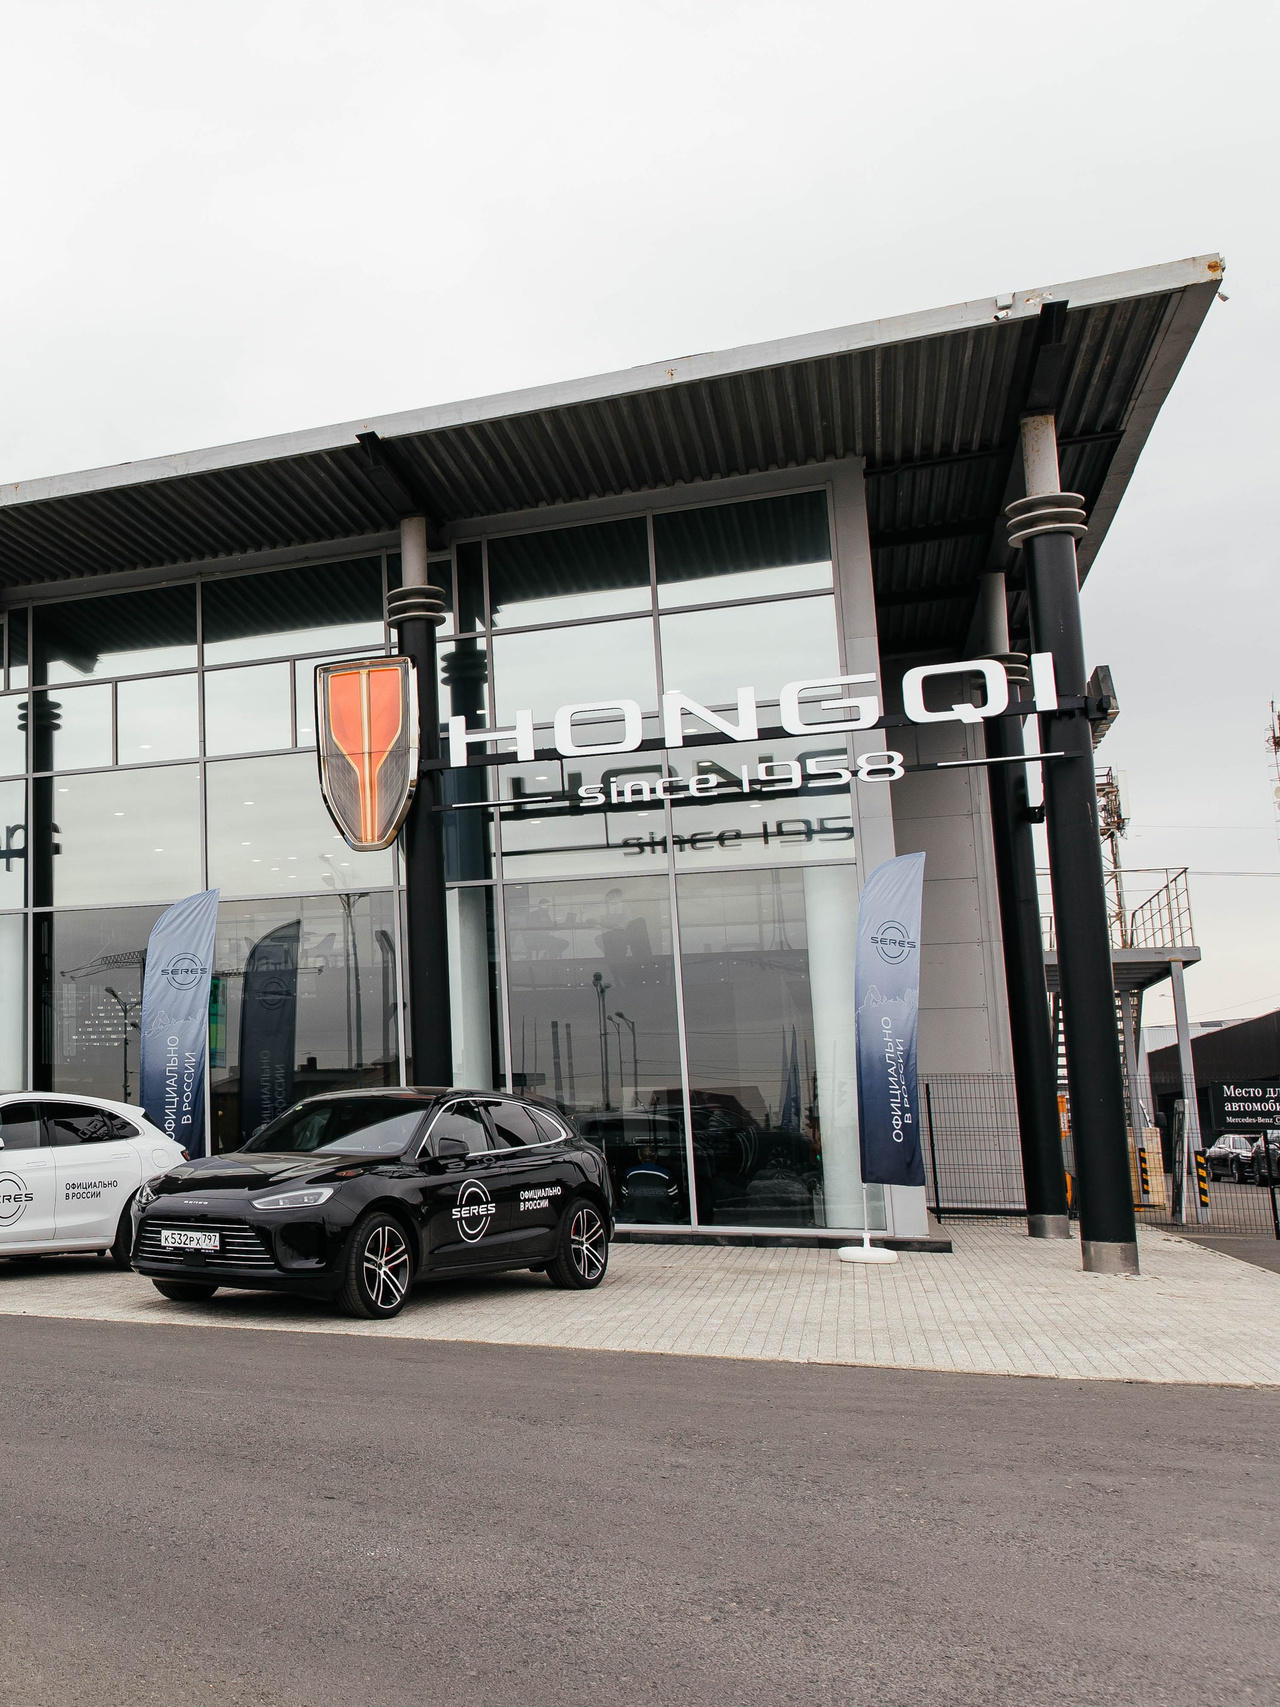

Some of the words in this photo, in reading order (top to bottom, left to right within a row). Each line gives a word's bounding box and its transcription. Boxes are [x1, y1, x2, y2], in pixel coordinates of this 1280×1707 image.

[448, 652, 1058, 767] HONGQI
[577, 774, 719, 807] since
[740, 750, 905, 793] 1958
[870, 936, 917, 949] SERES
[160, 967, 208, 976] SERES
[895, 1037, 911, 1109] РОССИИ
[182, 1051, 196, 1111] РОССИИ
[881, 1016, 904, 1144] ОФИЦИАЛЬНО
[1222, 1084, 1263, 1097] Место
[181, 1114, 192, 1125] В
[903, 1111, 913, 1124] В
[1226, 1116, 1274, 1124] Mercedes-Benz
[65, 1180, 118, 1191] ОФИЦИАЛЬНО
[65, 1191, 70, 1201] В
[71, 1191, 101, 1200] РОССИИ
[519, 1186, 562, 1200] ОФИЦИАЛЬНО
[451, 1203, 496, 1219] SERES
[525, 1199, 549, 1211] РОССИИ
